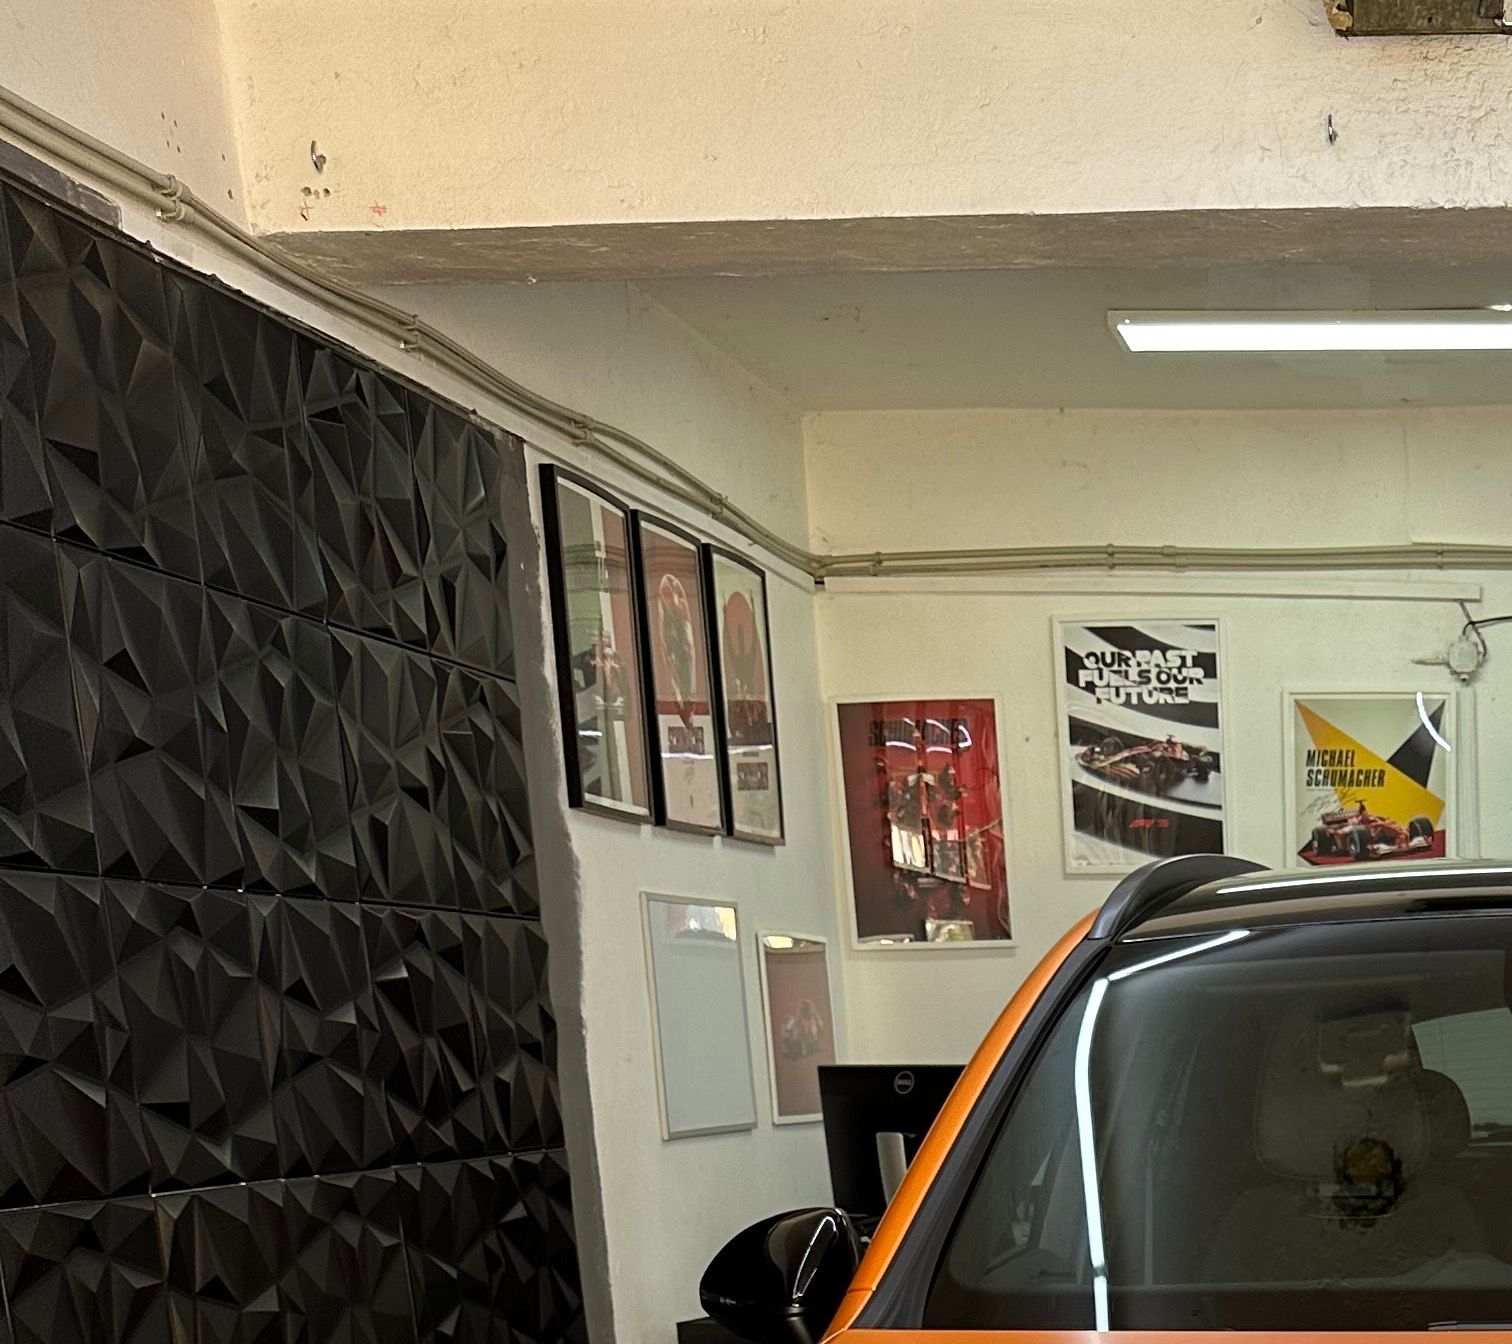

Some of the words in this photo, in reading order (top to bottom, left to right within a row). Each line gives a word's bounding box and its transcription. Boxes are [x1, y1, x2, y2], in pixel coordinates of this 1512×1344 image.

[1083, 651, 1132, 669] OUR
[1134, 650, 1198, 668] PAST
[1078, 668, 1152, 688] FUELS
[1155, 667, 1205, 685] OUR
[1095, 686, 1190, 704] FUTURE
[1306, 749, 1356, 767] MICHAEL
[1306, 768, 1387, 787] SCHUMACHER
